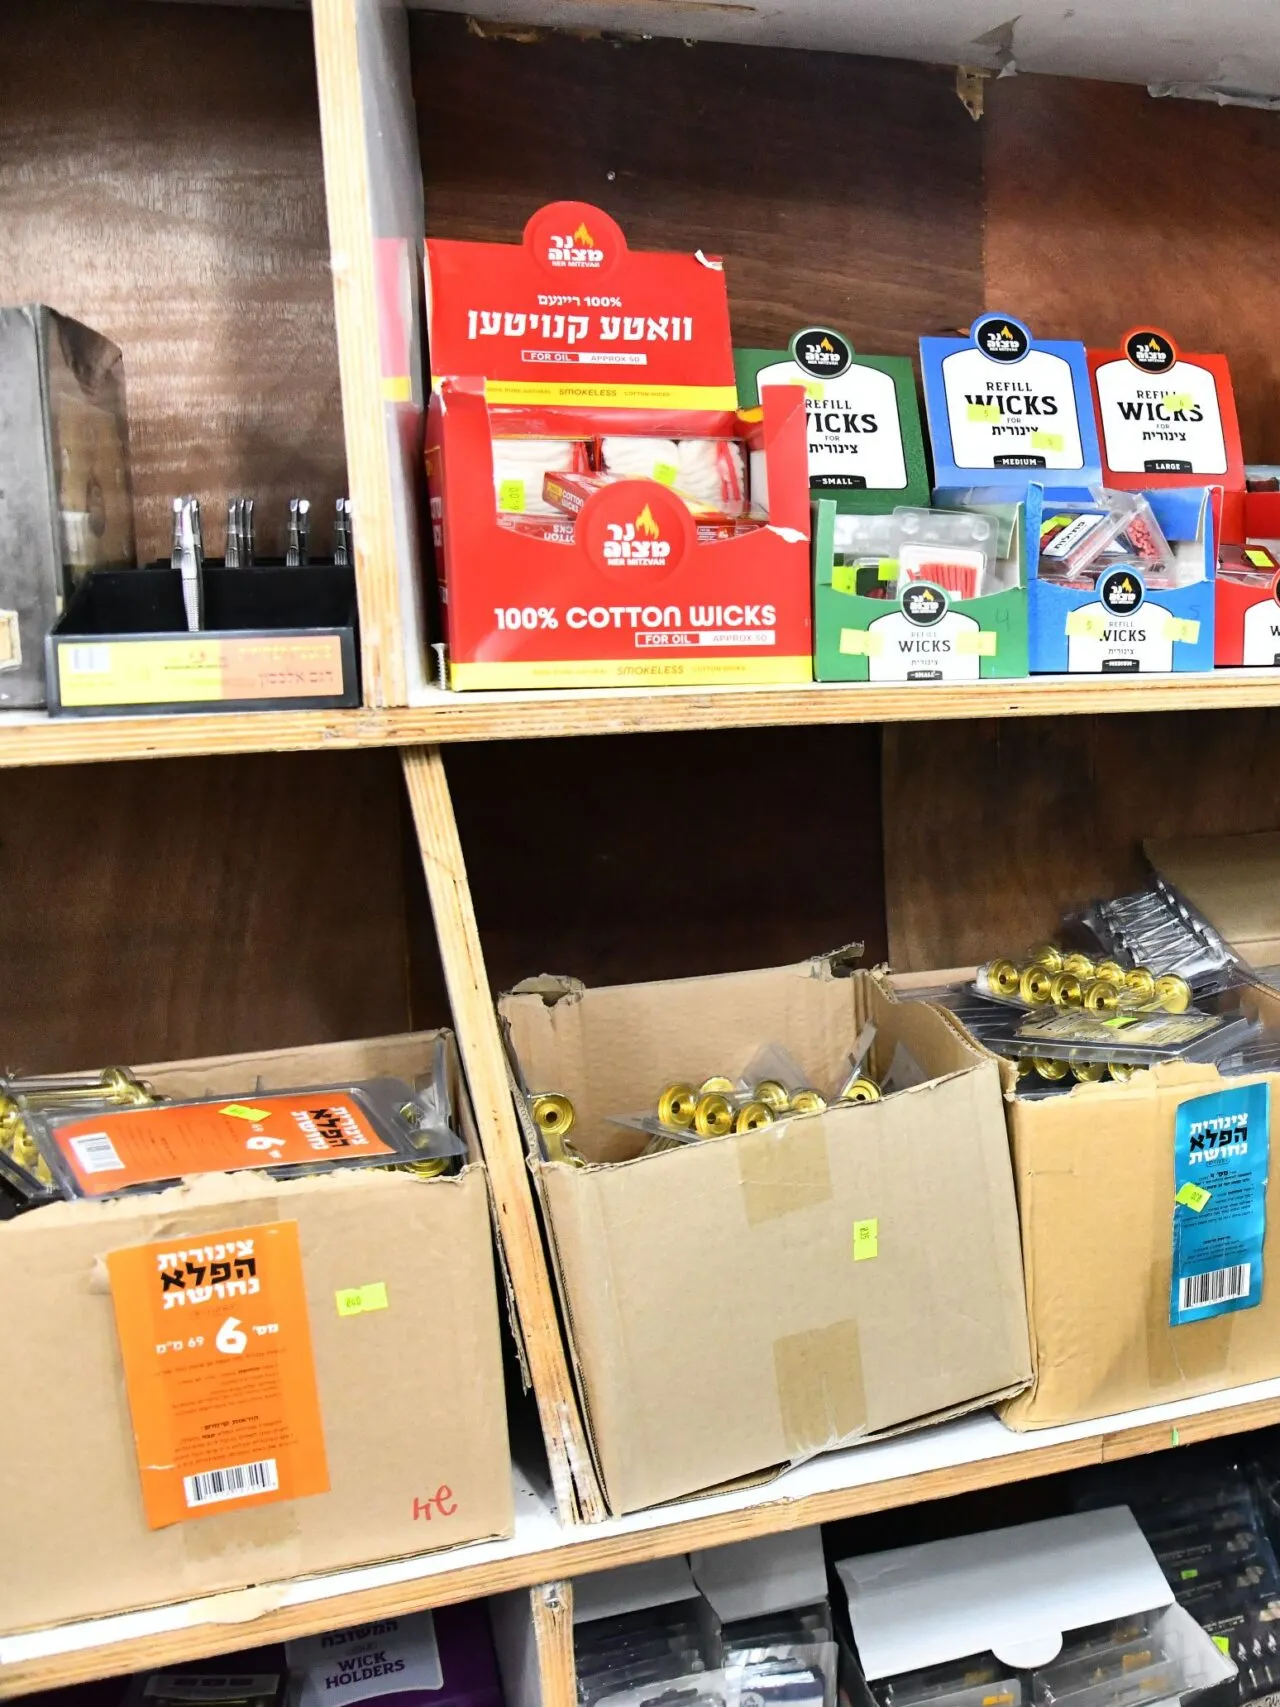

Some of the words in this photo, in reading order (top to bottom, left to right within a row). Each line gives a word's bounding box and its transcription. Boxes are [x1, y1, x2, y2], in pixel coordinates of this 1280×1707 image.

[550, 235, 573, 248] נר
[548, 248, 603, 262] מצוה
[537, 293, 580, 307] ריינעם
[583, 296, 622, 308] 100%
[468, 309, 589, 344] קנויטען
[599, 315, 693, 341] וואטע
[530, 352, 551, 361] FOR
[554, 353, 571, 362] OIL
[591, 355, 626, 363] APPROX
[628, 355, 640, 363] 50
[559, 388, 617, 397] SMOKELESS
[986, 382, 1033, 392] REFILL
[805, 399, 852, 410] REFILL
[1142, 431, 1186, 441] צינורית
[809, 443, 858, 454] צינורית
[1002, 458, 1037, 466] MEDIUM
[822, 477, 852, 485] SMALL
[607, 524, 635, 540] נר
[603, 540, 671, 559] מצוה
[607, 558, 625, 566] NER
[627, 558, 665, 566] MITZVAH
[494, 607, 558, 630] 100%
[566, 606, 681, 629] COTTON
[690, 605, 776, 628] WICKS
[645, 635, 668, 644] FOR
[671, 634, 691, 644] OIL
[713, 635, 752, 643] APPROX
[755, 634, 767, 642] 50
[898, 640, 951, 653] WICKS
[617, 665, 684, 676] SMOKELESS
[290, 1110, 330, 1150] נחושת
[308, 1109, 350, 1147] הפלא
[329, 1107, 370, 1145] צינורית
[1190, 1112, 1248, 1134] צינורית
[246, 1136, 286, 1150] 6
[1189, 1126, 1248, 1152] הפלא
[1189, 1145, 1248, 1165] נחושת
[157, 1239, 255, 1271] צינורית
[160, 1257, 256, 1292] הפלא
[163, 1279, 260, 1310] נחושת
[188, 1336, 204, 1348] 69
[216, 1316, 248, 1354] 6
[337, 1651, 386, 1671] WICK
[325, 1659, 405, 1689] HOLDERS
